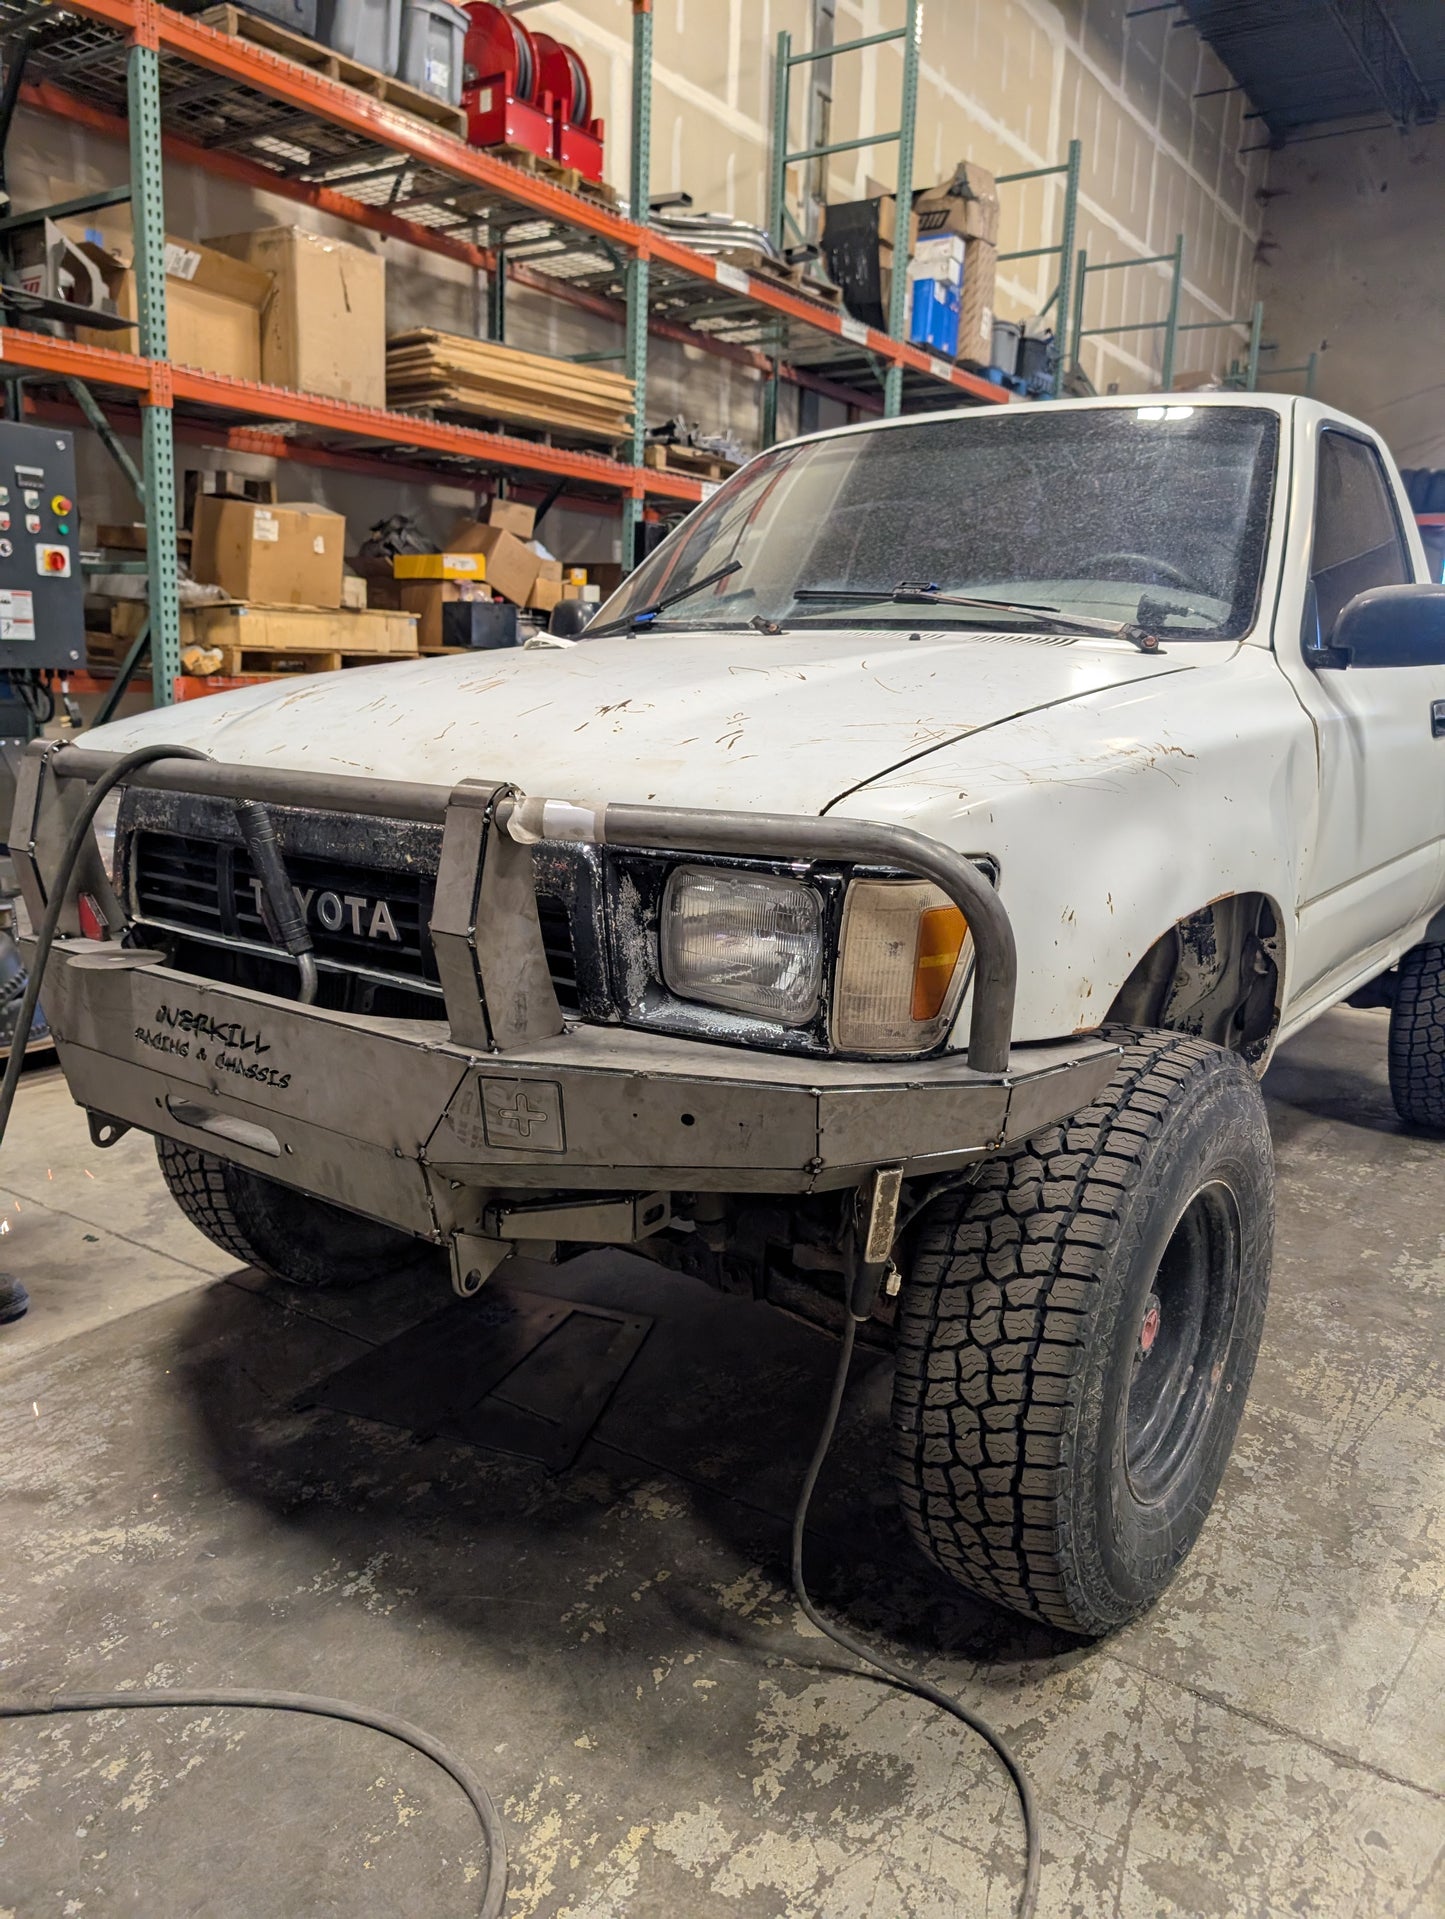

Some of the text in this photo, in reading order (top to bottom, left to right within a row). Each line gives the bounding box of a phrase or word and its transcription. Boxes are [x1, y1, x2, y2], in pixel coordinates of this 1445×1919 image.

[249, 878, 399, 941] TYOTA
[135, 1027, 292, 1089] RACING & CHASSIS
[155, 1005, 271, 1055] OVERKILL
